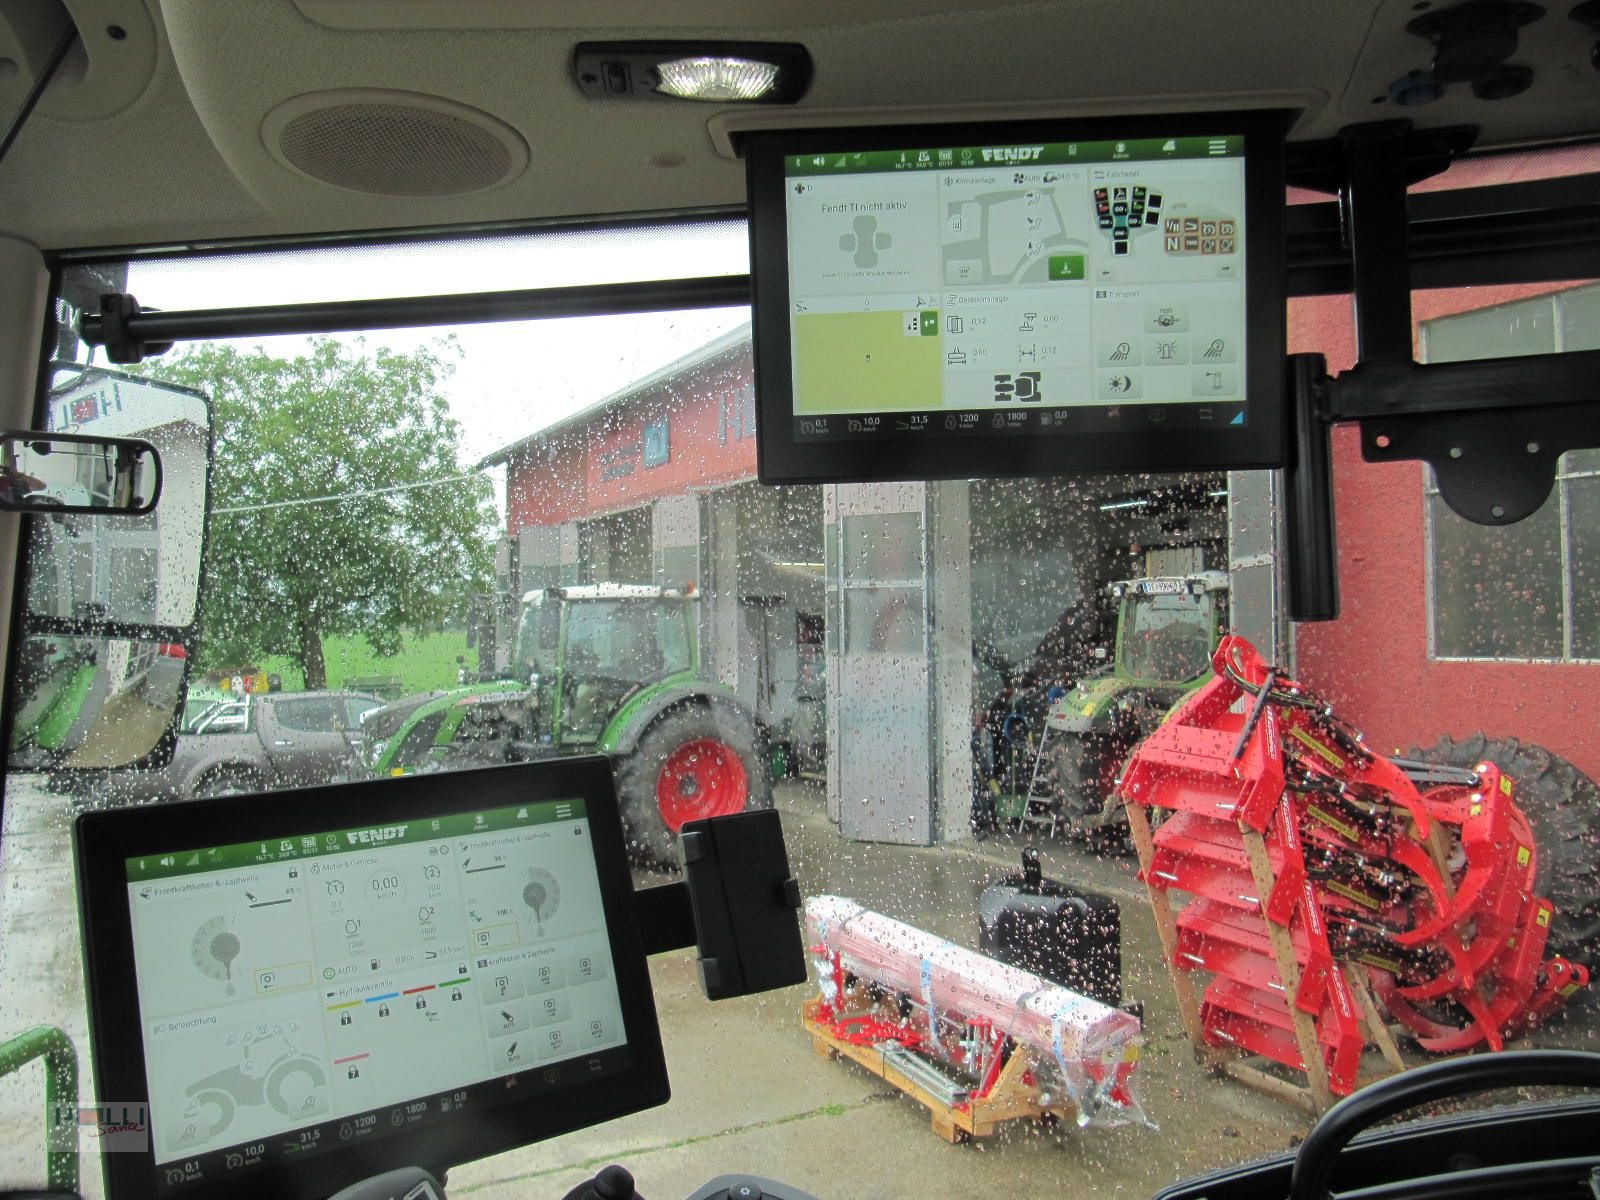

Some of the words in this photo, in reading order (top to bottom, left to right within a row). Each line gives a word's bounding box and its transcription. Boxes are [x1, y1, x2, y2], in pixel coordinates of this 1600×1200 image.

[981, 146, 1044, 161] FENDT
[822, 204, 848, 214] Fendt
[850, 204, 858, 212] TI
[861, 202, 883, 211] nicht
[885, 201, 908, 210] aktiv
[1109, 290, 1140, 298] Transport
[864, 417, 880, 426] 10,0
[910, 416, 928, 424] 31,5
[959, 414, 979, 422] 1200
[1008, 412, 1028, 421] 1800
[346, 825, 408, 845] FENDT
[372, 876, 398, 891] 0,00
[377, 892, 397, 900] km/h
[338, 966, 358, 975] AUTO
[406, 1102, 427, 1114] 1800
[354, 1114, 377, 1128] 1200
[300, 1130, 320, 1142] 31,5
[245, 1144, 264, 1156] 10,0
[186, 1161, 199, 1173] 0,1
